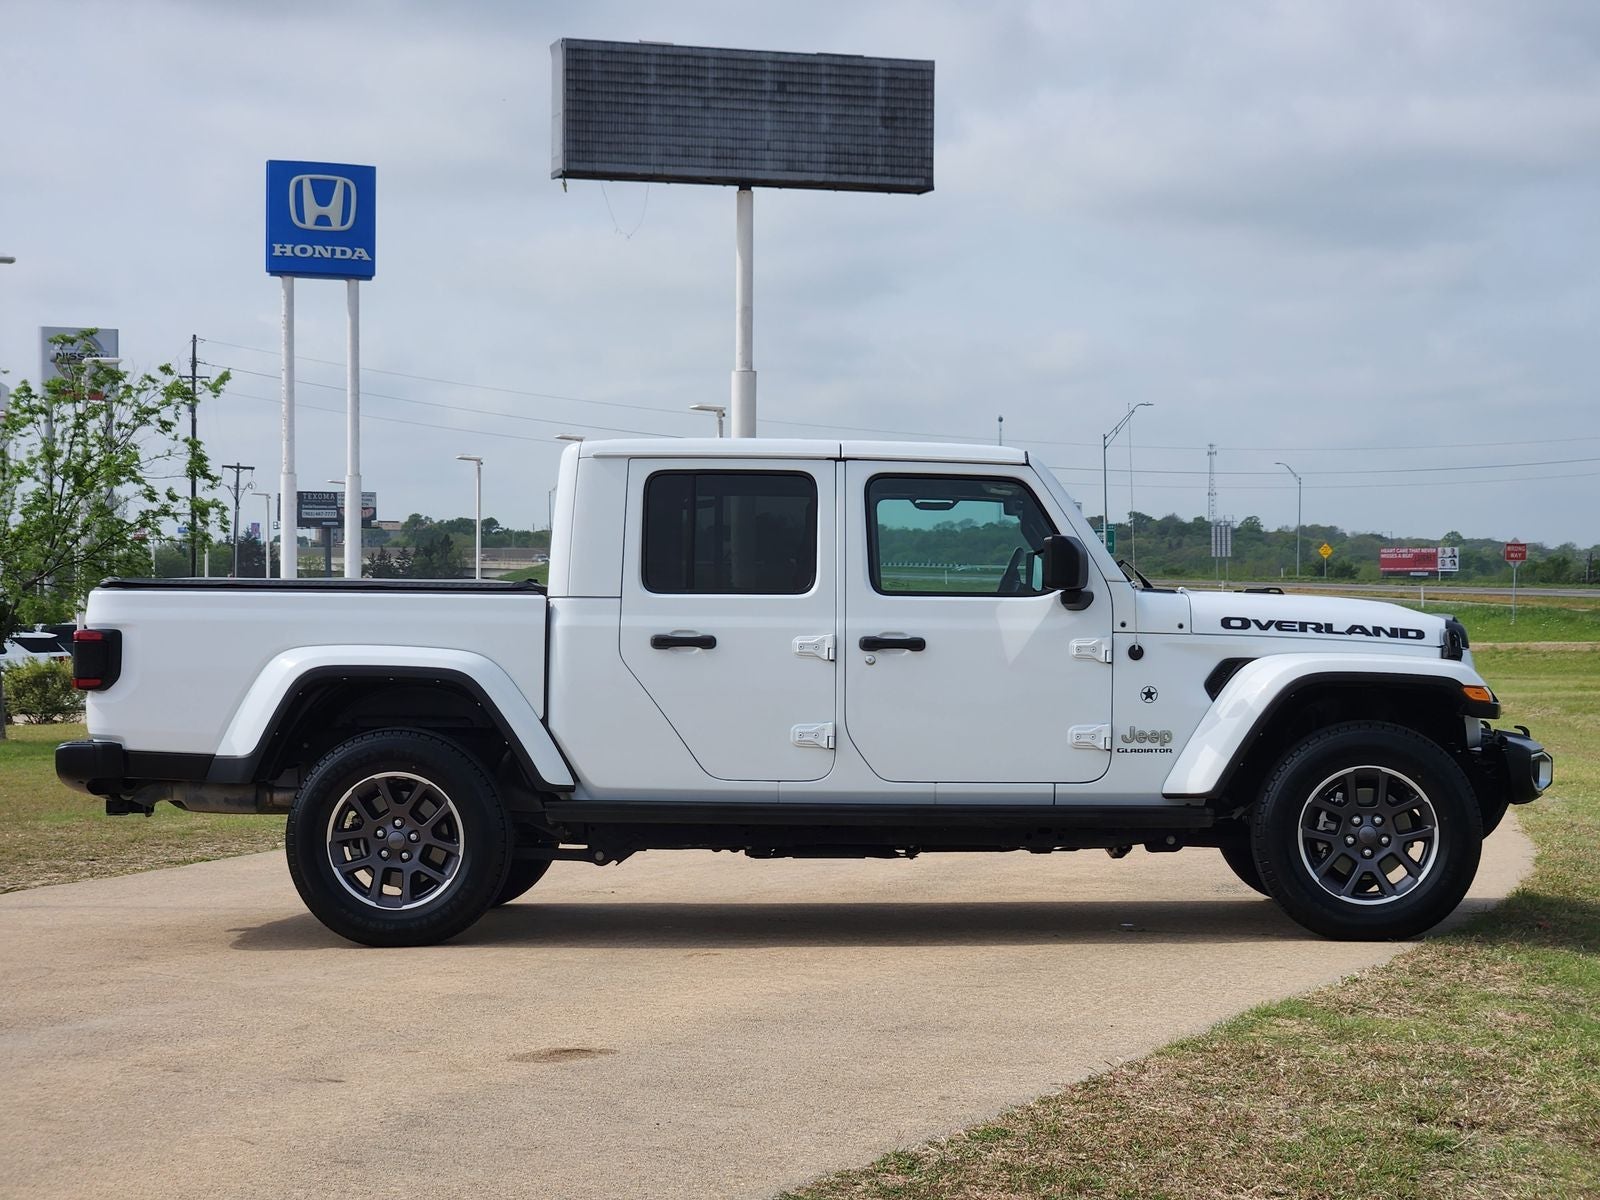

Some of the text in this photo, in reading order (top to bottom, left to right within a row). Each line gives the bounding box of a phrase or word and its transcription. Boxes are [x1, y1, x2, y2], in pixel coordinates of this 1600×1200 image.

[272, 243, 372, 261] HONDA
[1220, 616, 1426, 640] OVERLAND
[1121, 726, 1172, 746] Jeep
